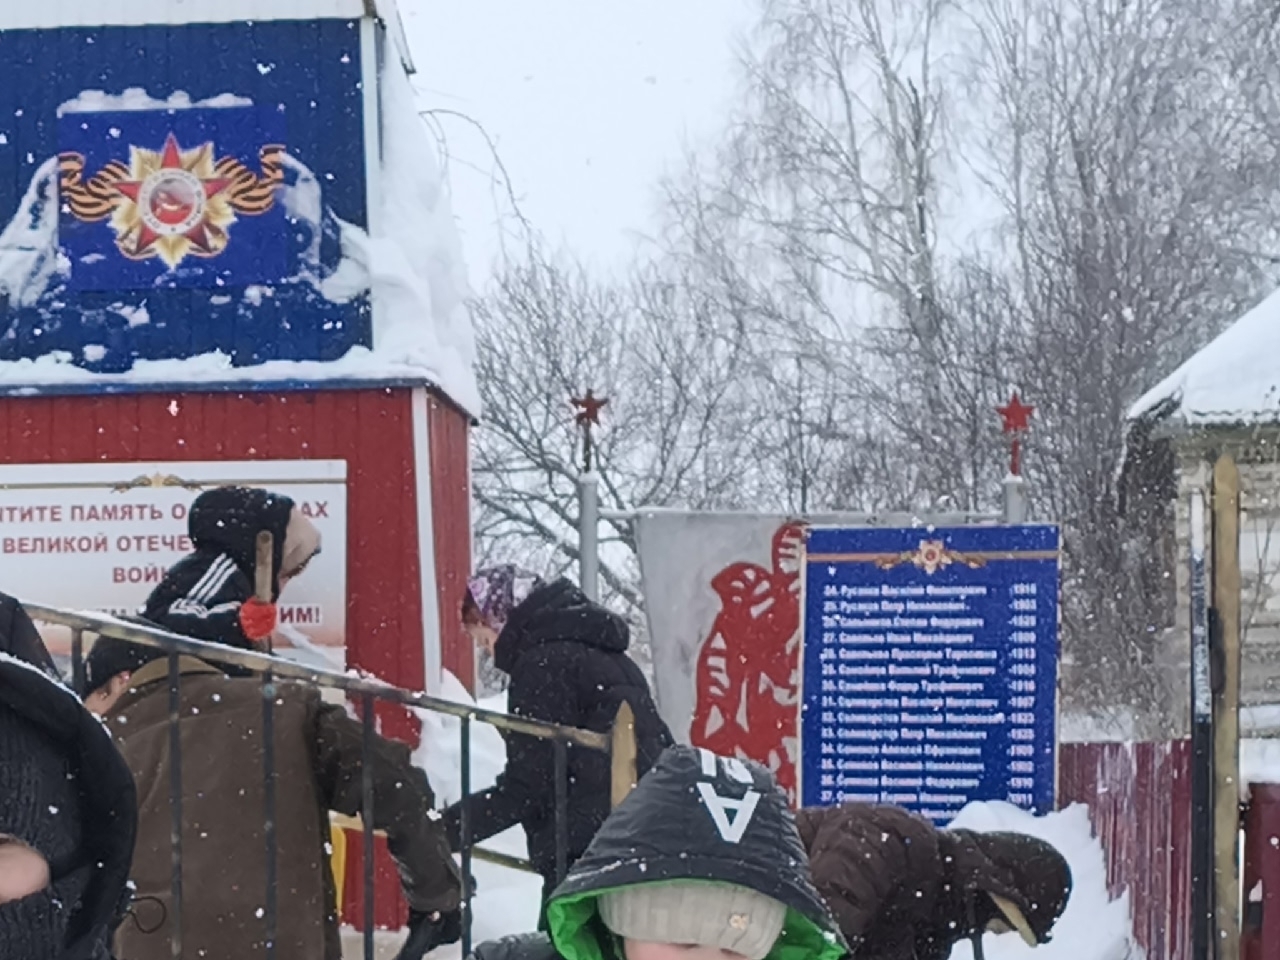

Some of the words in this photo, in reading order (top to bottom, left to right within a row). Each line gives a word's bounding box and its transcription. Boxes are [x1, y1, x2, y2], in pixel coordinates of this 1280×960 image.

[71, 504, 163, 521] ПАМЯТЬ
[171, 503, 186, 519] О
[301, 501, 329, 519] АХ
[2, 532, 108, 554] ВЕЛИКОЙ
[116, 534, 194, 552] ОТЕЧЕ
[280, 606, 320, 624] ИМ!
